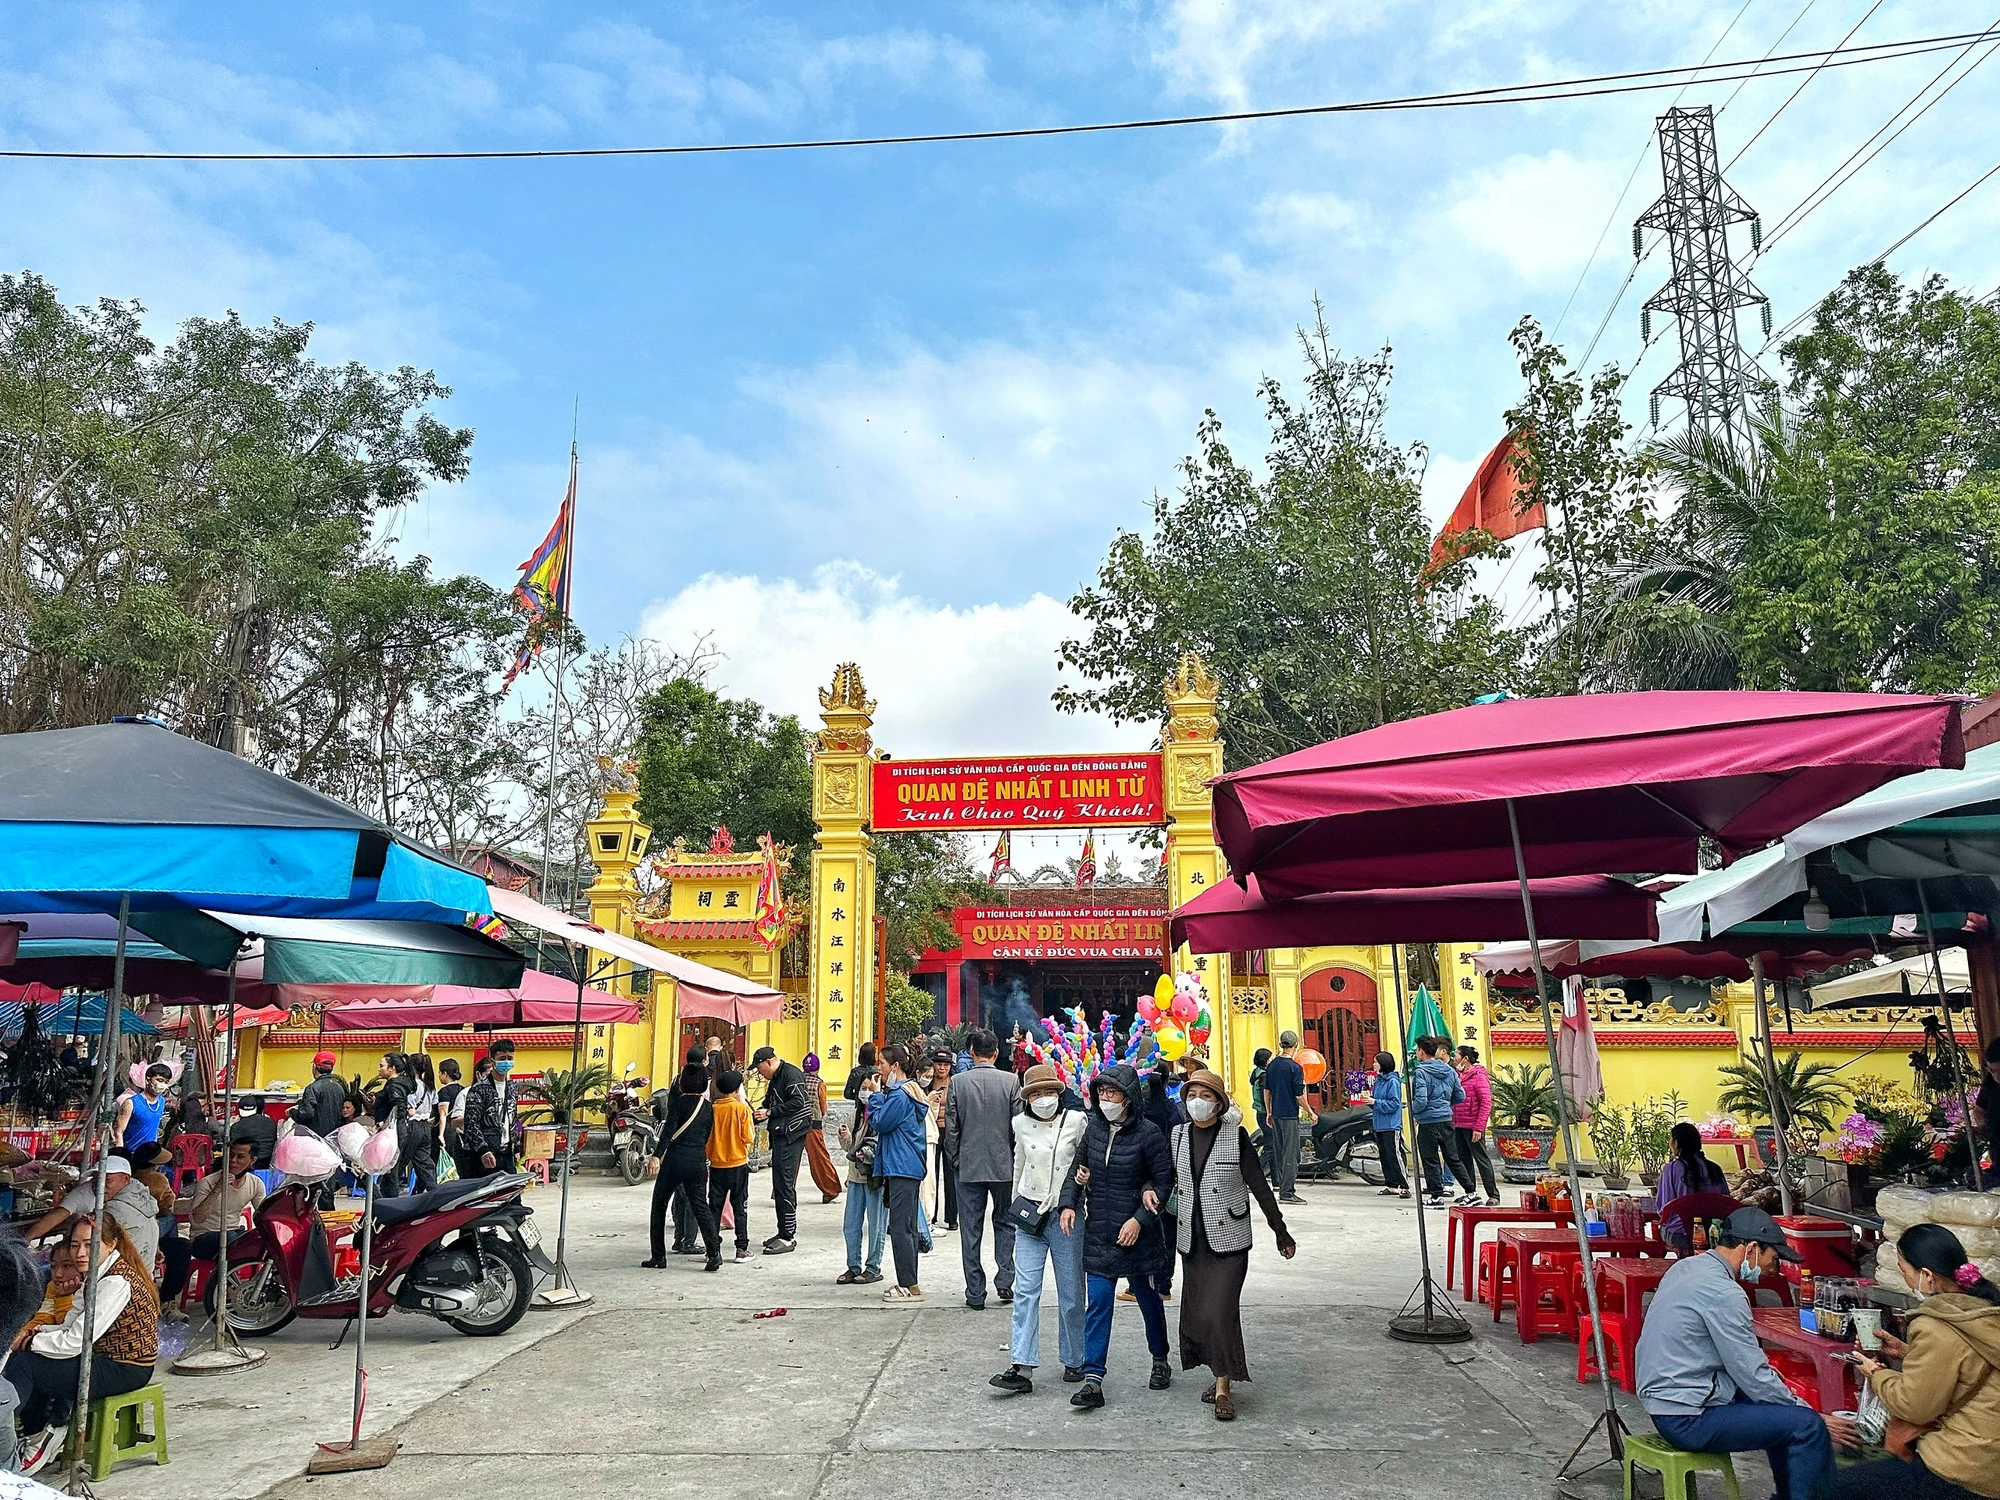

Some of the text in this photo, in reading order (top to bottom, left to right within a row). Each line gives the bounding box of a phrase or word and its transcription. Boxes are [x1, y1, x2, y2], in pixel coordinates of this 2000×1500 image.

[892, 768, 902, 776] DI
[904, 766, 925, 776] TÍCH
[926, 766, 946, 777] LỊCH
[949, 764, 962, 775] SỬ
[964, 765, 982, 774] VĂN
[984, 763, 1003, 774] HOÁ
[1006, 762, 1025, 773] CẤP
[1027, 761, 1052, 773] QUỐC
[1053, 763, 1069, 772] GIA
[897, 773, 1146, 804] QUAN ĐỆ NHẤT LINH TỪ
[897, 803, 1154, 822] Kính Chào Quý Khách!
[987, 909, 1005, 918] TÍCH
[1006, 910, 1023, 919] LỊCH
[1025, 908, 1036, 918] SỬ
[1038, 909, 1054, 917] VĂN
[1074, 907, 1091, 917] CẤP
[1093, 907, 1114, 918] QUỐC
[1116, 909, 1130, 917] GIA
[972, 924, 1031, 945] QUAN
[1037, 919, 1065, 944] ĐỆ
[1070, 918, 1128, 941] NHẤT
[992, 945, 1021, 959] CẬN
[1046, 945, 1077, 957] ĐỨC
[1079, 947, 1108, 957] VUA
[1112, 947, 1141, 957] CHA
[1145, 944, 1164, 957] BÁ
